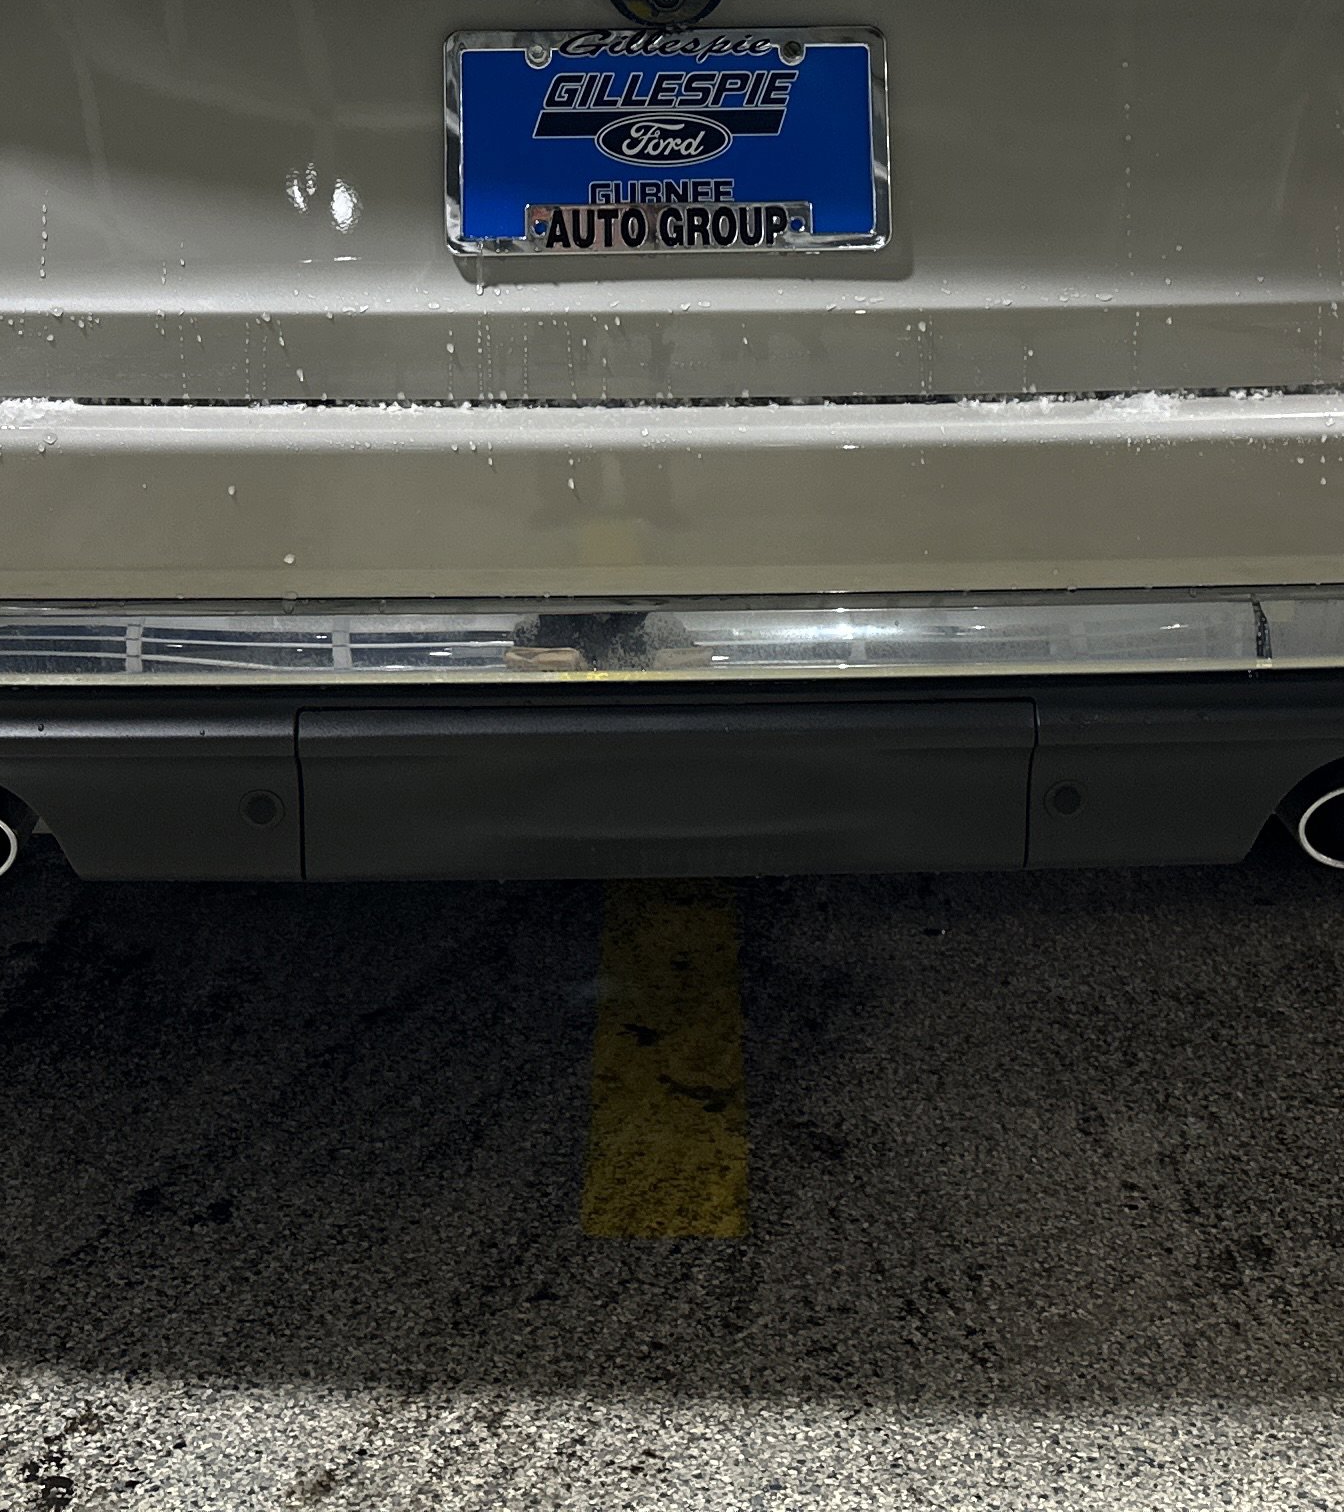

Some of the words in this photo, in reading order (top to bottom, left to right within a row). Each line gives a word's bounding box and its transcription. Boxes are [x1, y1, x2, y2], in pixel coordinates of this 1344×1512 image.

[559, 29, 775, 64] Gillespie
[543, 70, 799, 109] GILLESPIE
[621, 121, 706, 157] Ford
[589, 178, 735, 204] GURNEE
[545, 206, 648, 248] AUTO
[659, 206, 789, 249] GROUP
